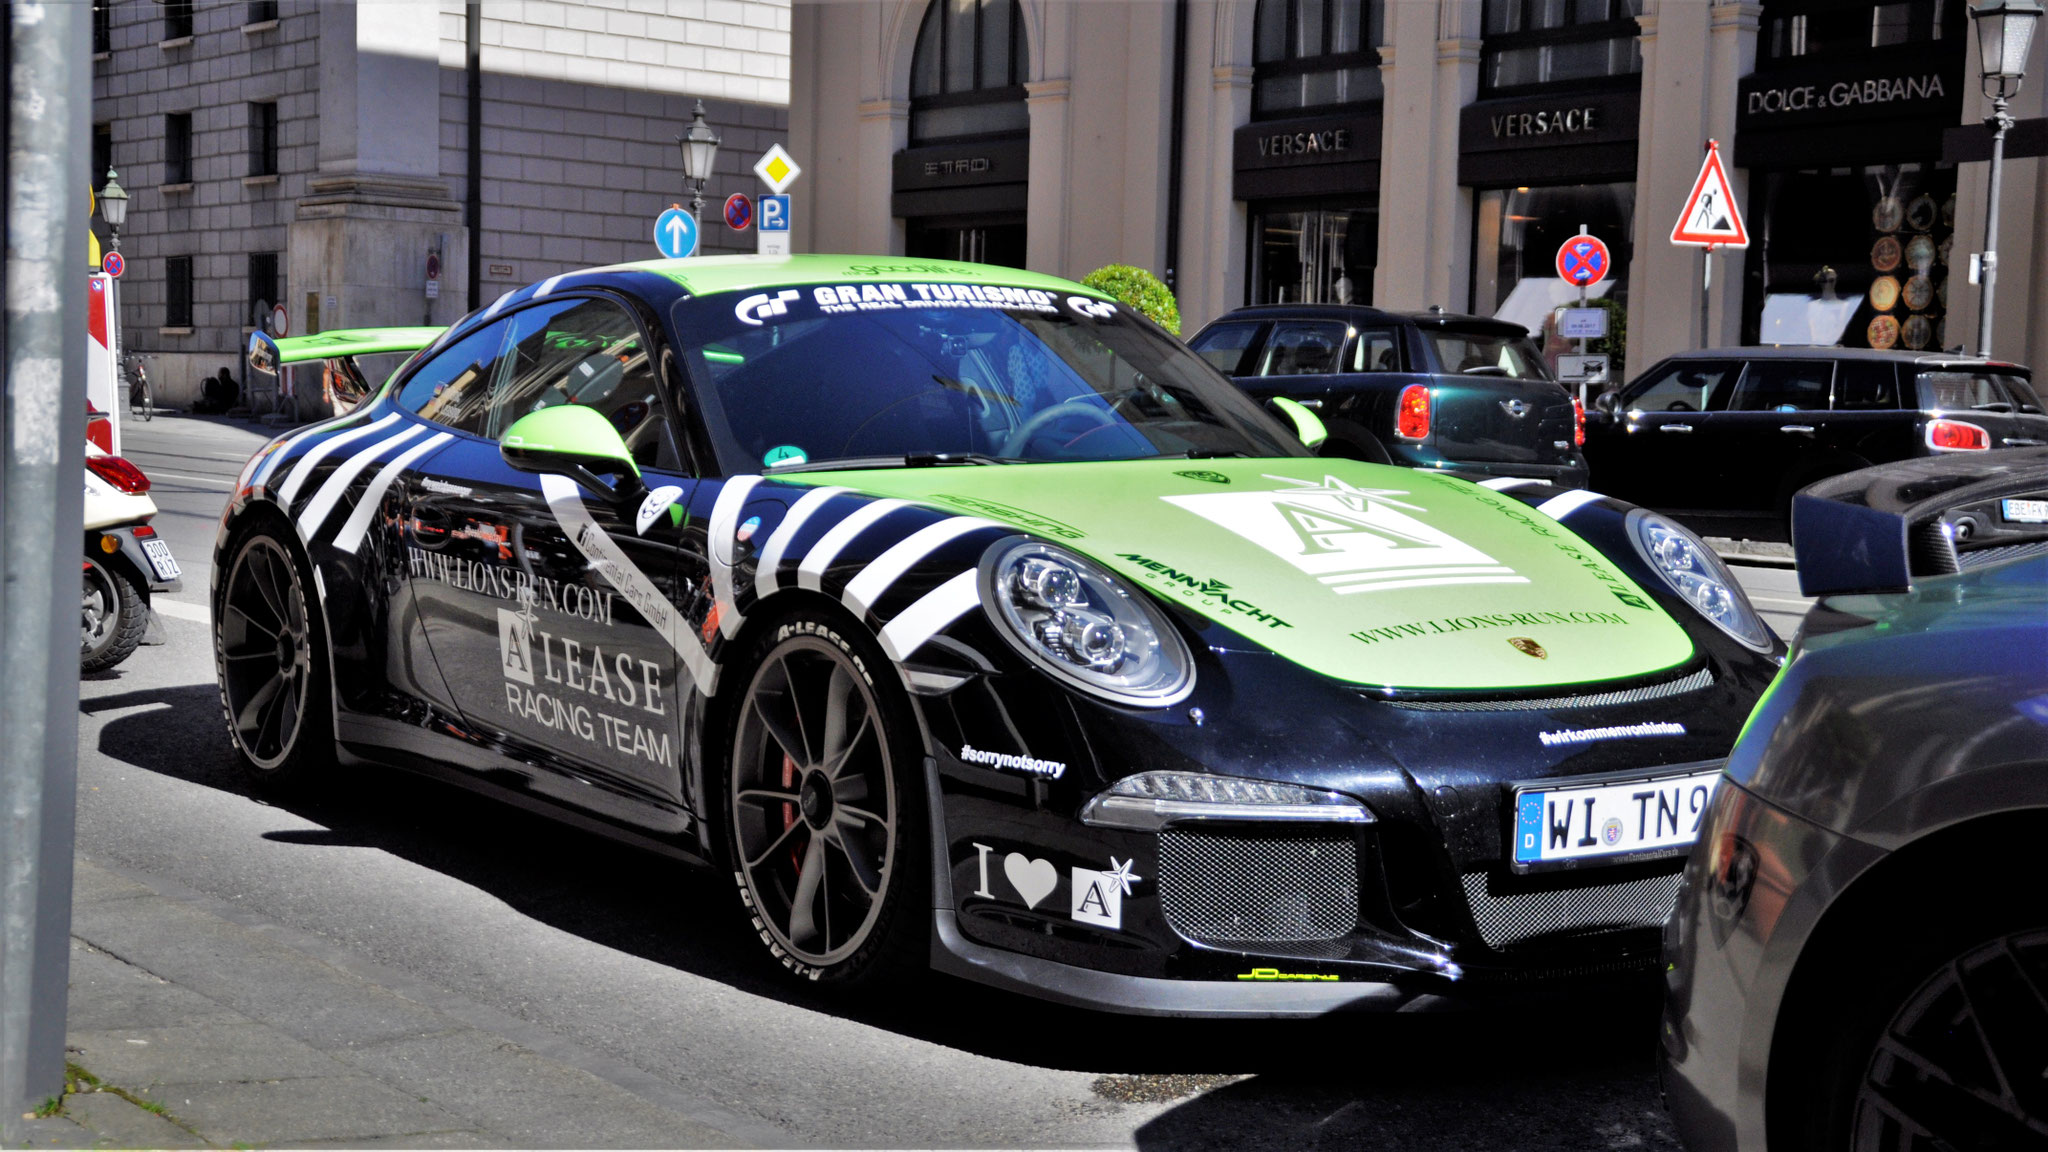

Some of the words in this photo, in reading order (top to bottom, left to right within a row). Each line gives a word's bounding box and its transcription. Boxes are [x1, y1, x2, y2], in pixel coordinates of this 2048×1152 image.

[1747, 86, 1815, 114] DOLCE
[1818, 96, 1826, 108] &
[1829, 74, 1944, 106] GABBANA
[1259, 130, 1345, 156] VERSACE
[1491, 108, 1595, 138] VERSACE
[813, 283, 907, 306] GRAN
[820, 302, 858, 314] THE
[857, 300, 902, 311] REAL
[903, 299, 970, 309] DRIVING
[146, 541, 169, 559] 300
[408, 546, 613, 627] WWW.LIONS-RUN.COM
[624, 573, 643, 608] Cars
[643, 592, 668, 630] GmbH
[1114, 553, 1295, 629] MENNYACHT
[1145, 572, 1233, 615] GROUP
[1349, 611, 1630, 645] WWW.LIONS-RUN.COM
[540, 630, 666, 716] LEASE
[505, 682, 595, 742] RACING
[598, 712, 672, 768] TEAM
[1539, 721, 1687, 746] #wirkommenvonhinten
[961, 744, 1067, 779] #sorrynotsorry
[1525, 834, 1535, 849] D
[1548, 797, 1598, 851] WI
[1633, 787, 1680, 841] TN
[972, 842, 996, 900] I
